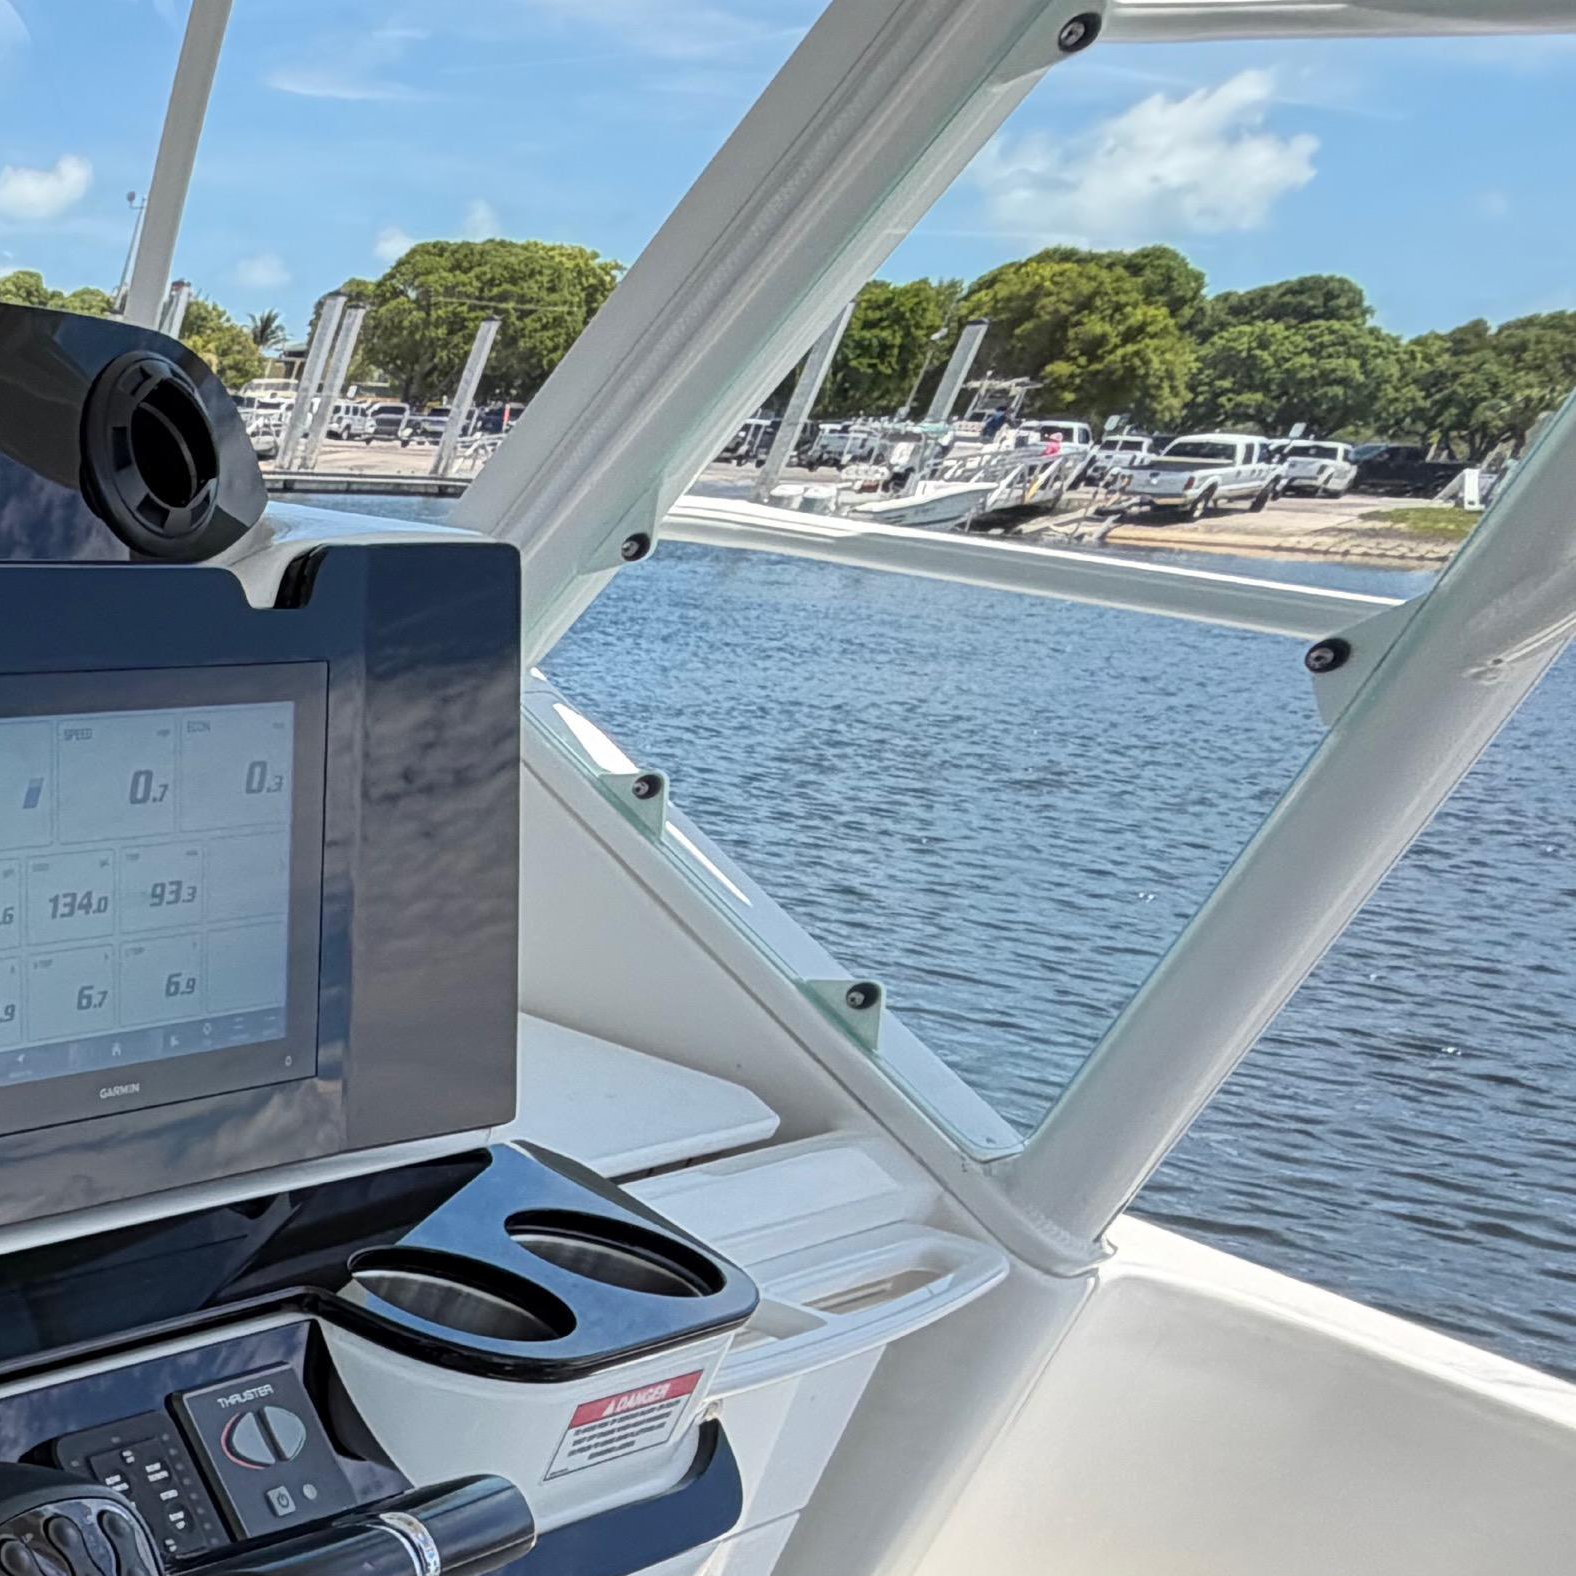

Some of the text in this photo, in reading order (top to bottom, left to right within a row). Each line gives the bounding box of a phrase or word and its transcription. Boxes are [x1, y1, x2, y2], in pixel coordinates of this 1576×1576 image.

[63, 728, 93, 741] SPEED
[128, 769, 169, 805] 0.7
[245, 760, 284, 795] 0.3
[49, 891, 109, 920] 134.0
[149, 880, 197, 907] 93.3
[77, 985, 109, 1010] 6.7
[165, 972, 196, 997] 6.9
[99, 1082, 140, 1099] GARMIN
[216, 1383, 275, 1409] THRUSTER
[615, 1382, 671, 1413] DANGER
